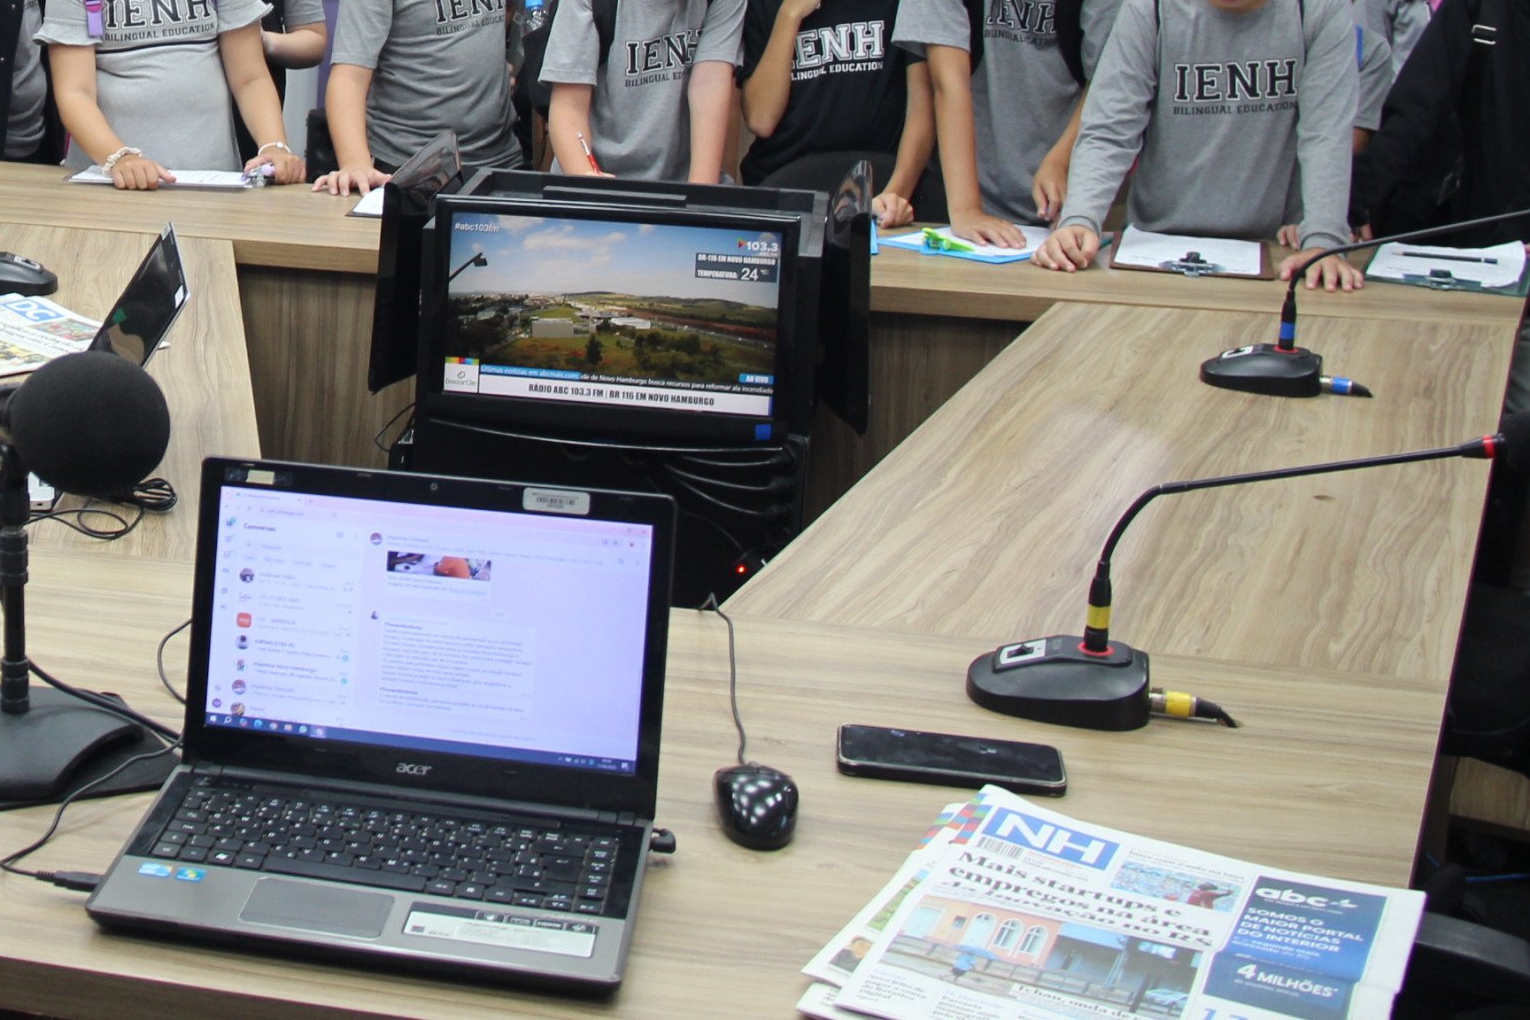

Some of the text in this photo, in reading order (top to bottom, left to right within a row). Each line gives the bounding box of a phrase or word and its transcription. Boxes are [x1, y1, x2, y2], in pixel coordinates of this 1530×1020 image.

[104, 22, 215, 42] BILINGUAL EDUCATION
[791, 20, 885, 70] ENH
[829, 61, 884, 74] EDUCATION
[625, 73, 670, 87] BILINGUAL
[1174, 59, 1298, 102] IENH
[1173, 101, 1298, 116] BILINGUAL EDUCATION
[454, 222, 499, 233] #abc103fm
[746, 241, 778, 252] 103.3
[740, 267, 759, 281] 24
[6, 299, 56, 320] DC
[599, 374, 615, 382] Novo
[616, 375, 647, 385] Hamburgo
[648, 377, 666, 385] busca
[529, 382, 715, 406] RÁDIO ABC 103.3 FM BR 116 EM NOVO HAMBURGO
[396, 762, 432, 775] acer
[995, 812, 1106, 865] NH
[958, 851, 1028, 880] Mais
[1031, 874, 1159, 917] startups
[1164, 907, 1182, 918] e
[948, 865, 1091, 911] empregos
[1096, 905, 1135, 920] na
[1140, 913, 1211, 937] área
[1247, 907, 1324, 926] SOMOS O
[1240, 921, 1341, 944] DE NOTÍCIAS
[1243, 914, 1365, 942] MAIOR PORTAL
[1237, 928, 1340, 952] DO INTERIOR
[1237, 964, 1257, 979] 4
